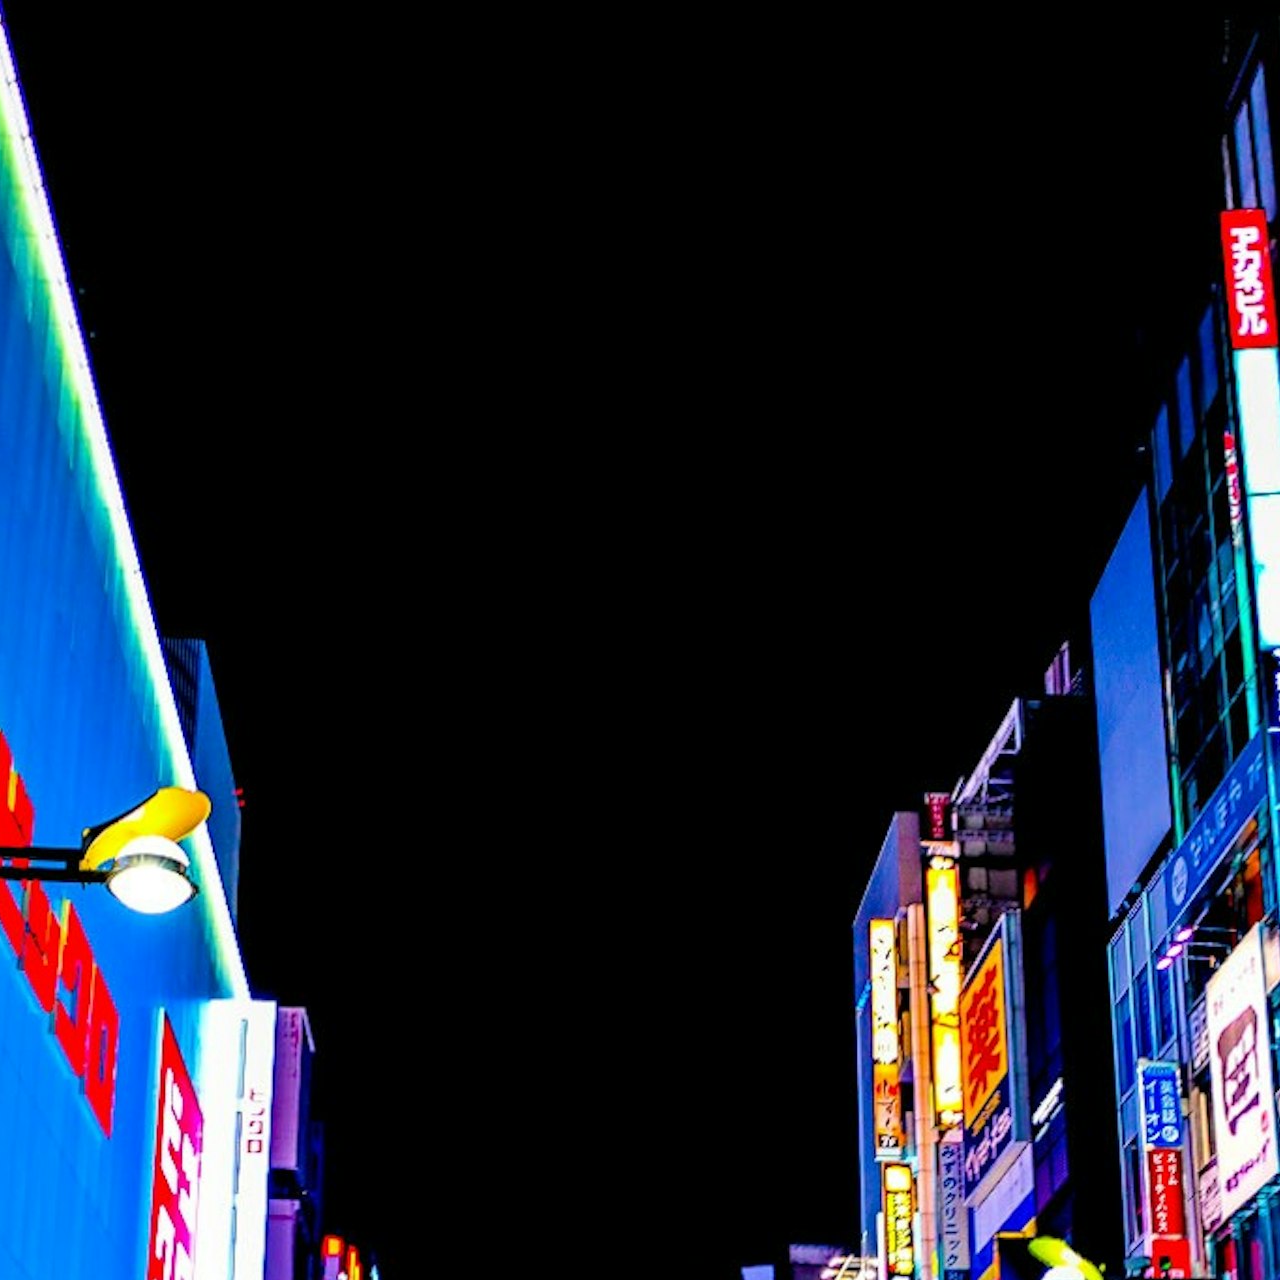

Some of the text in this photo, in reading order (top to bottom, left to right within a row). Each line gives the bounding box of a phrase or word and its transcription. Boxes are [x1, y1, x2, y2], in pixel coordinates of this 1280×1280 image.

[1229, 225, 1268, 336] アカネビル
